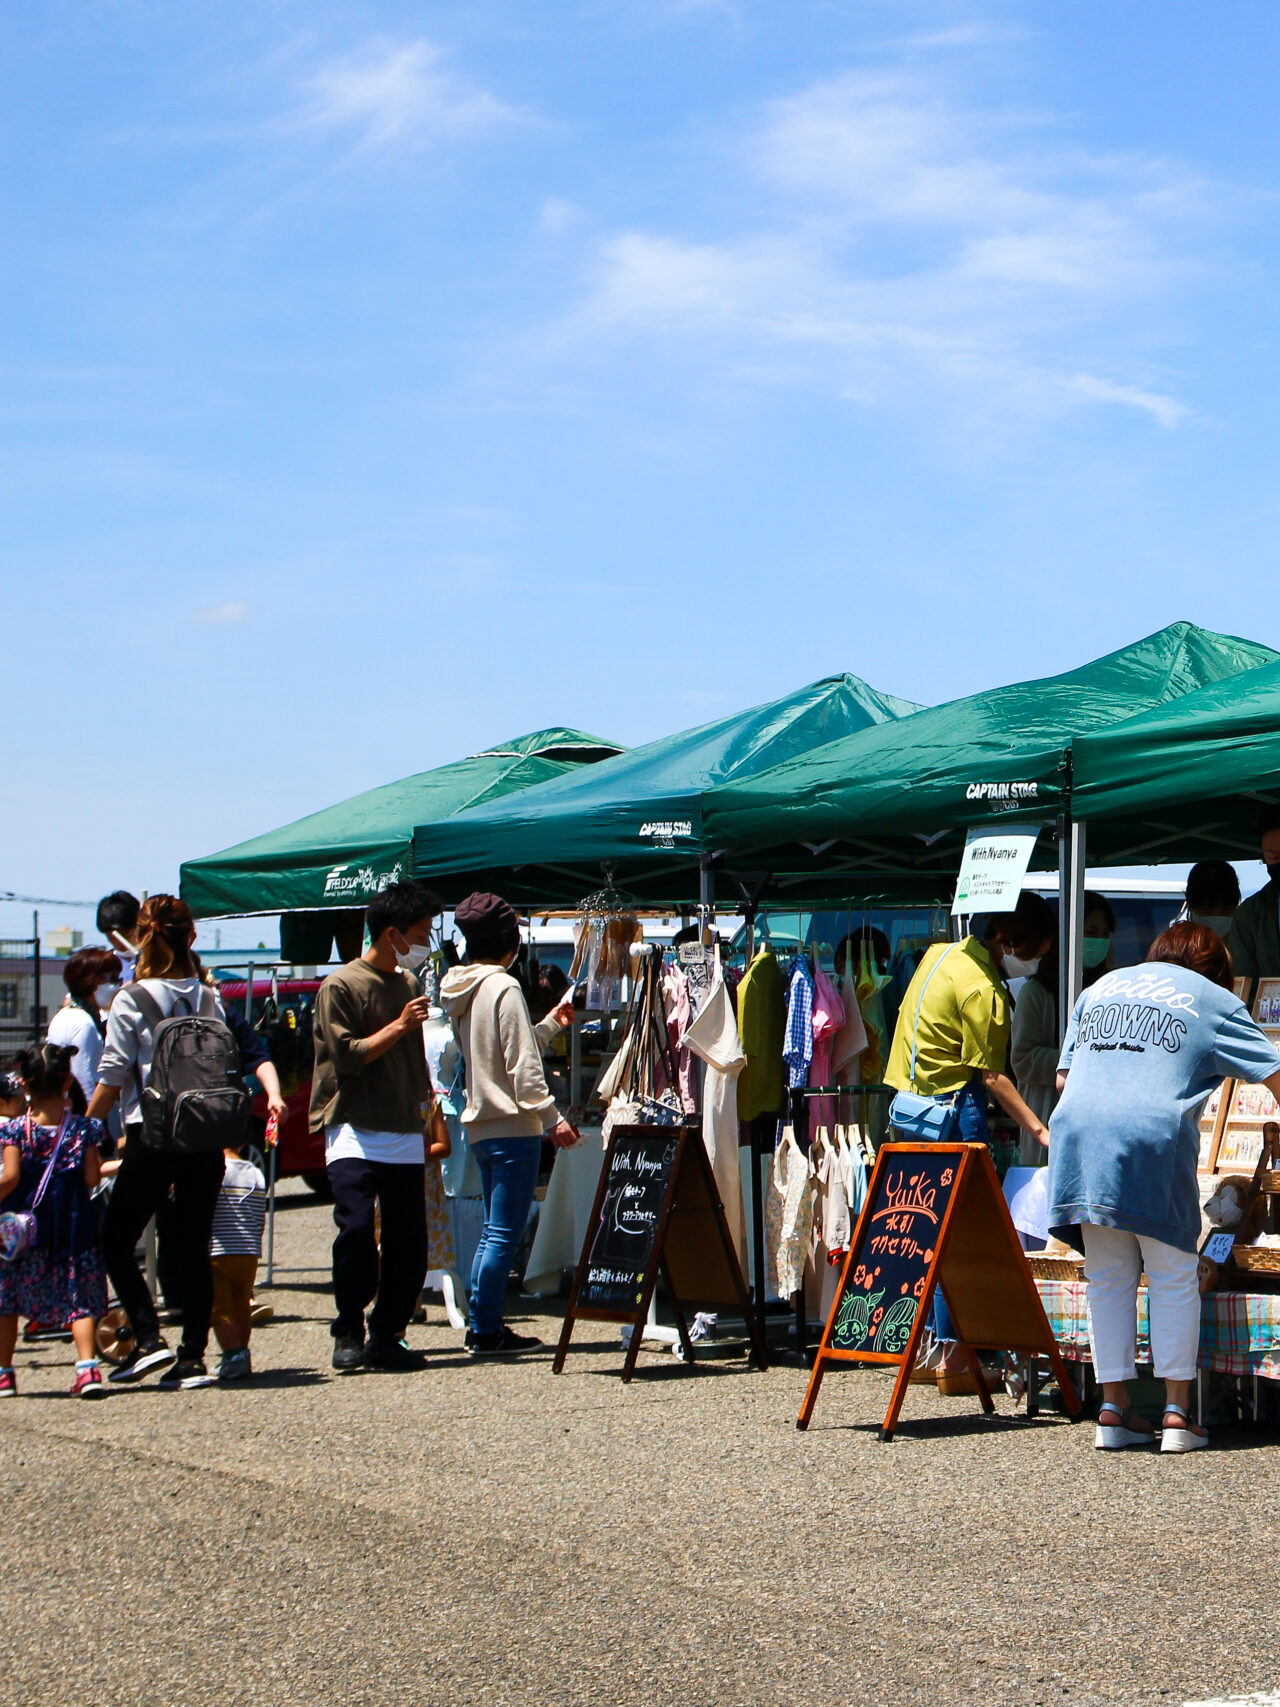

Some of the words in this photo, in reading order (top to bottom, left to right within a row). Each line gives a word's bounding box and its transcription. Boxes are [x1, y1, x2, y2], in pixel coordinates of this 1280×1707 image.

[966, 783, 1010, 799] CAPTAIN
[1010, 782, 1039, 798] STAG
[639, 822, 673, 836] CAPTAIN
[672, 821, 692, 836] STAG
[1086, 975, 1200, 1019] Rodeo
[1076, 1003, 1187, 1053] CROWNS
[871, 1235, 924, 1259] アクセサリー
